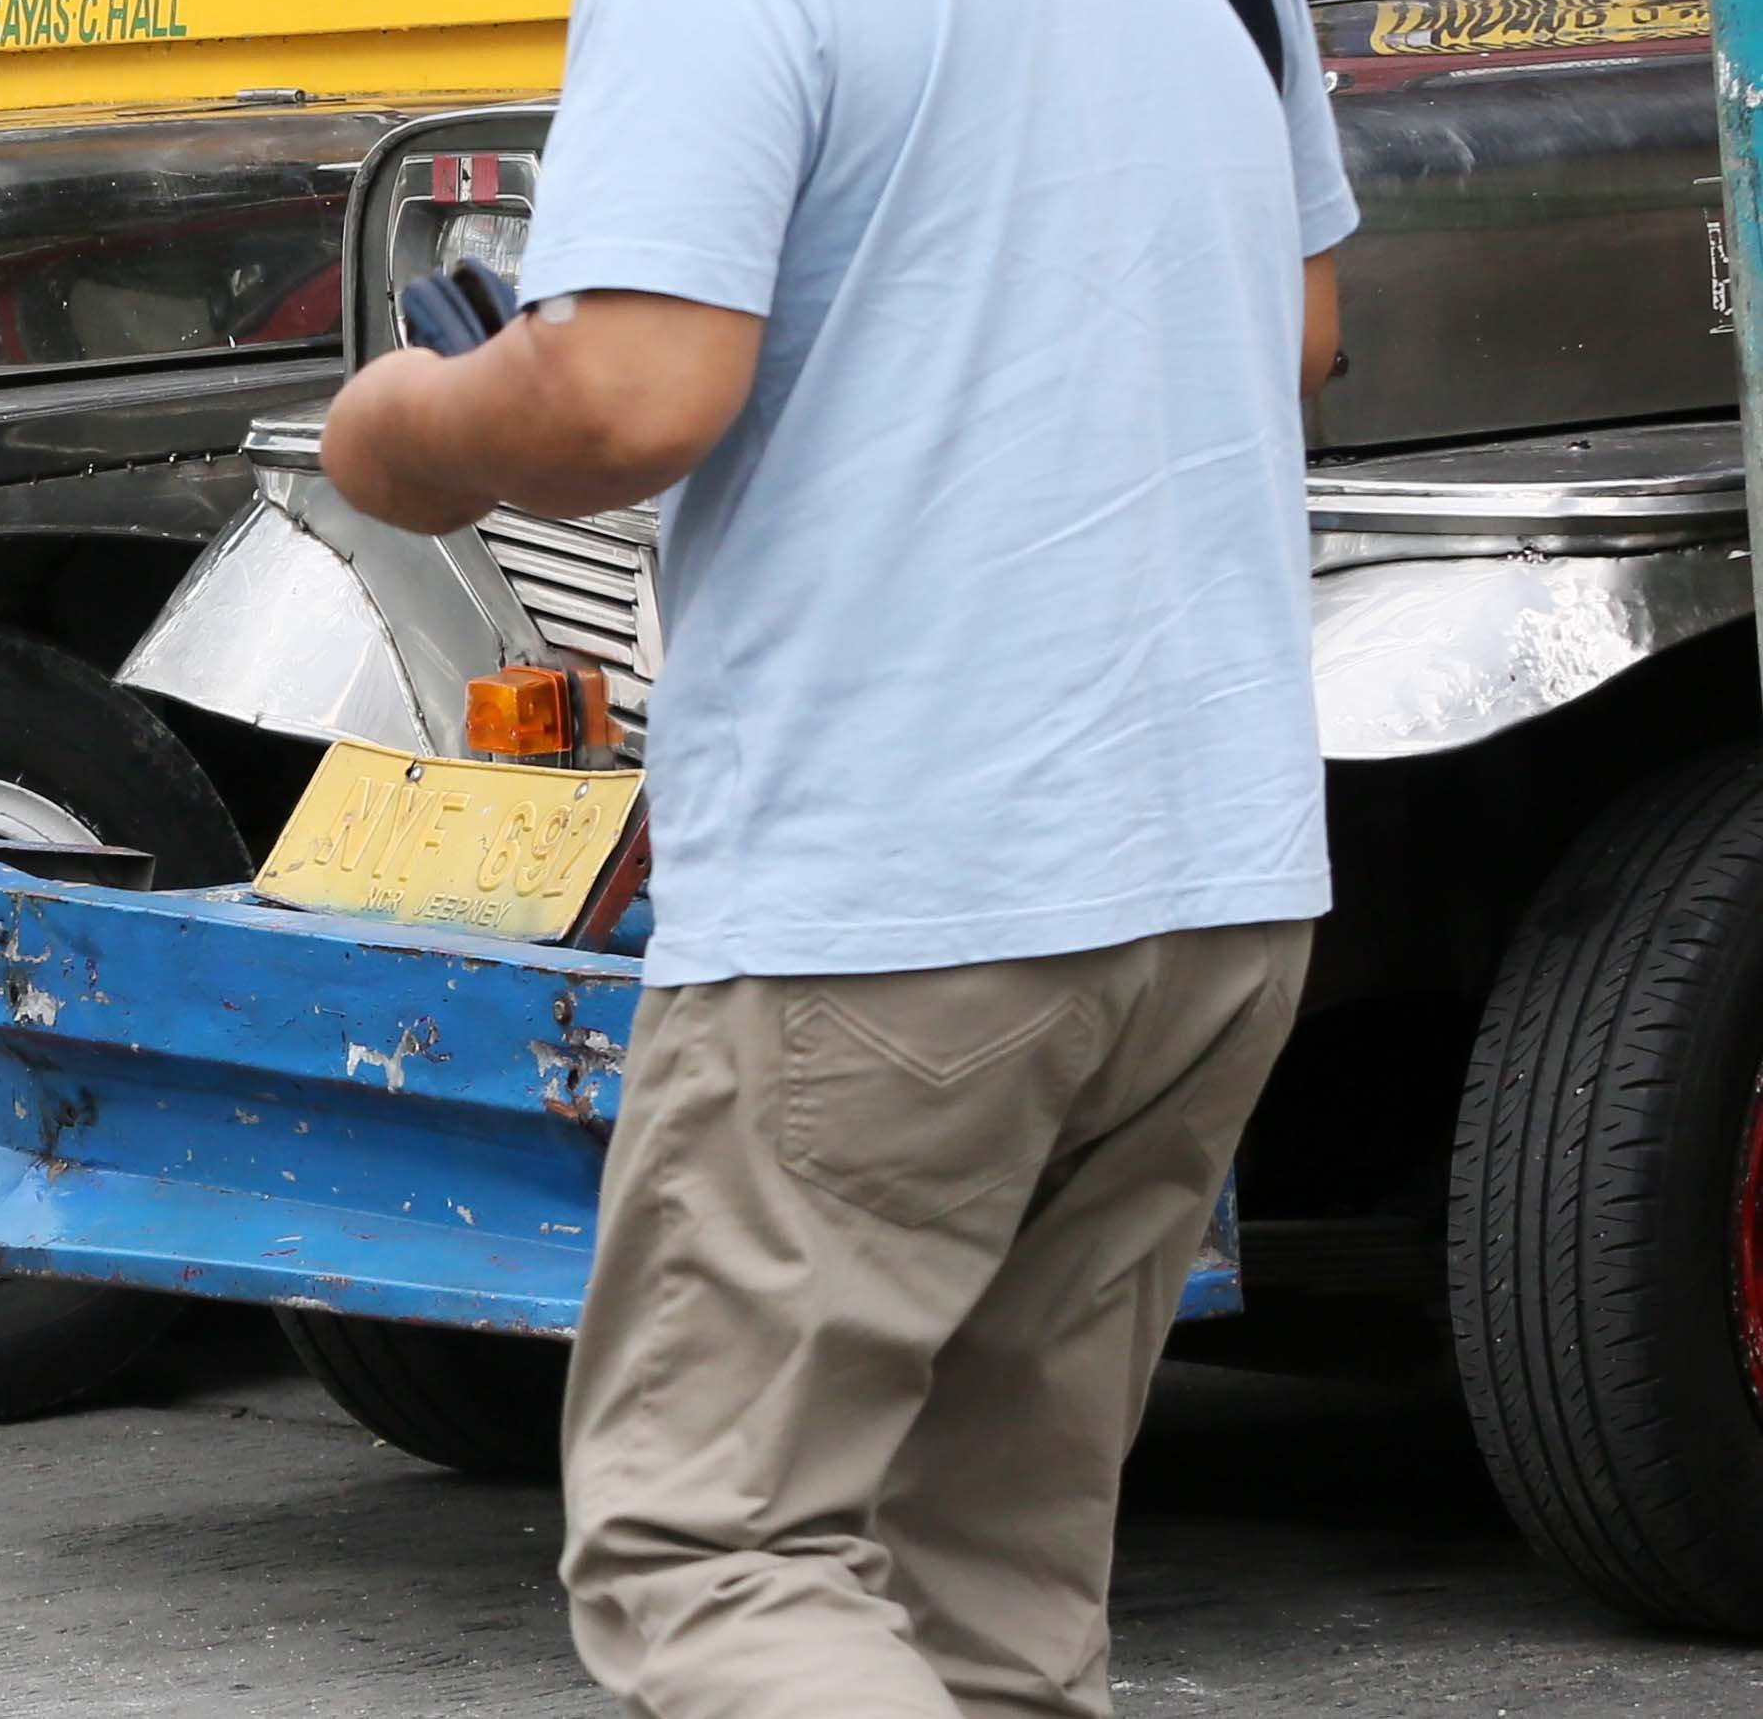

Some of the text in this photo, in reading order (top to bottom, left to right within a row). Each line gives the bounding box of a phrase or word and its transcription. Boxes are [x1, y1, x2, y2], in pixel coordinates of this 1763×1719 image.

[315, 777, 602, 898] NYF 692
[361, 885, 514, 927] NCR JEEPNEY
